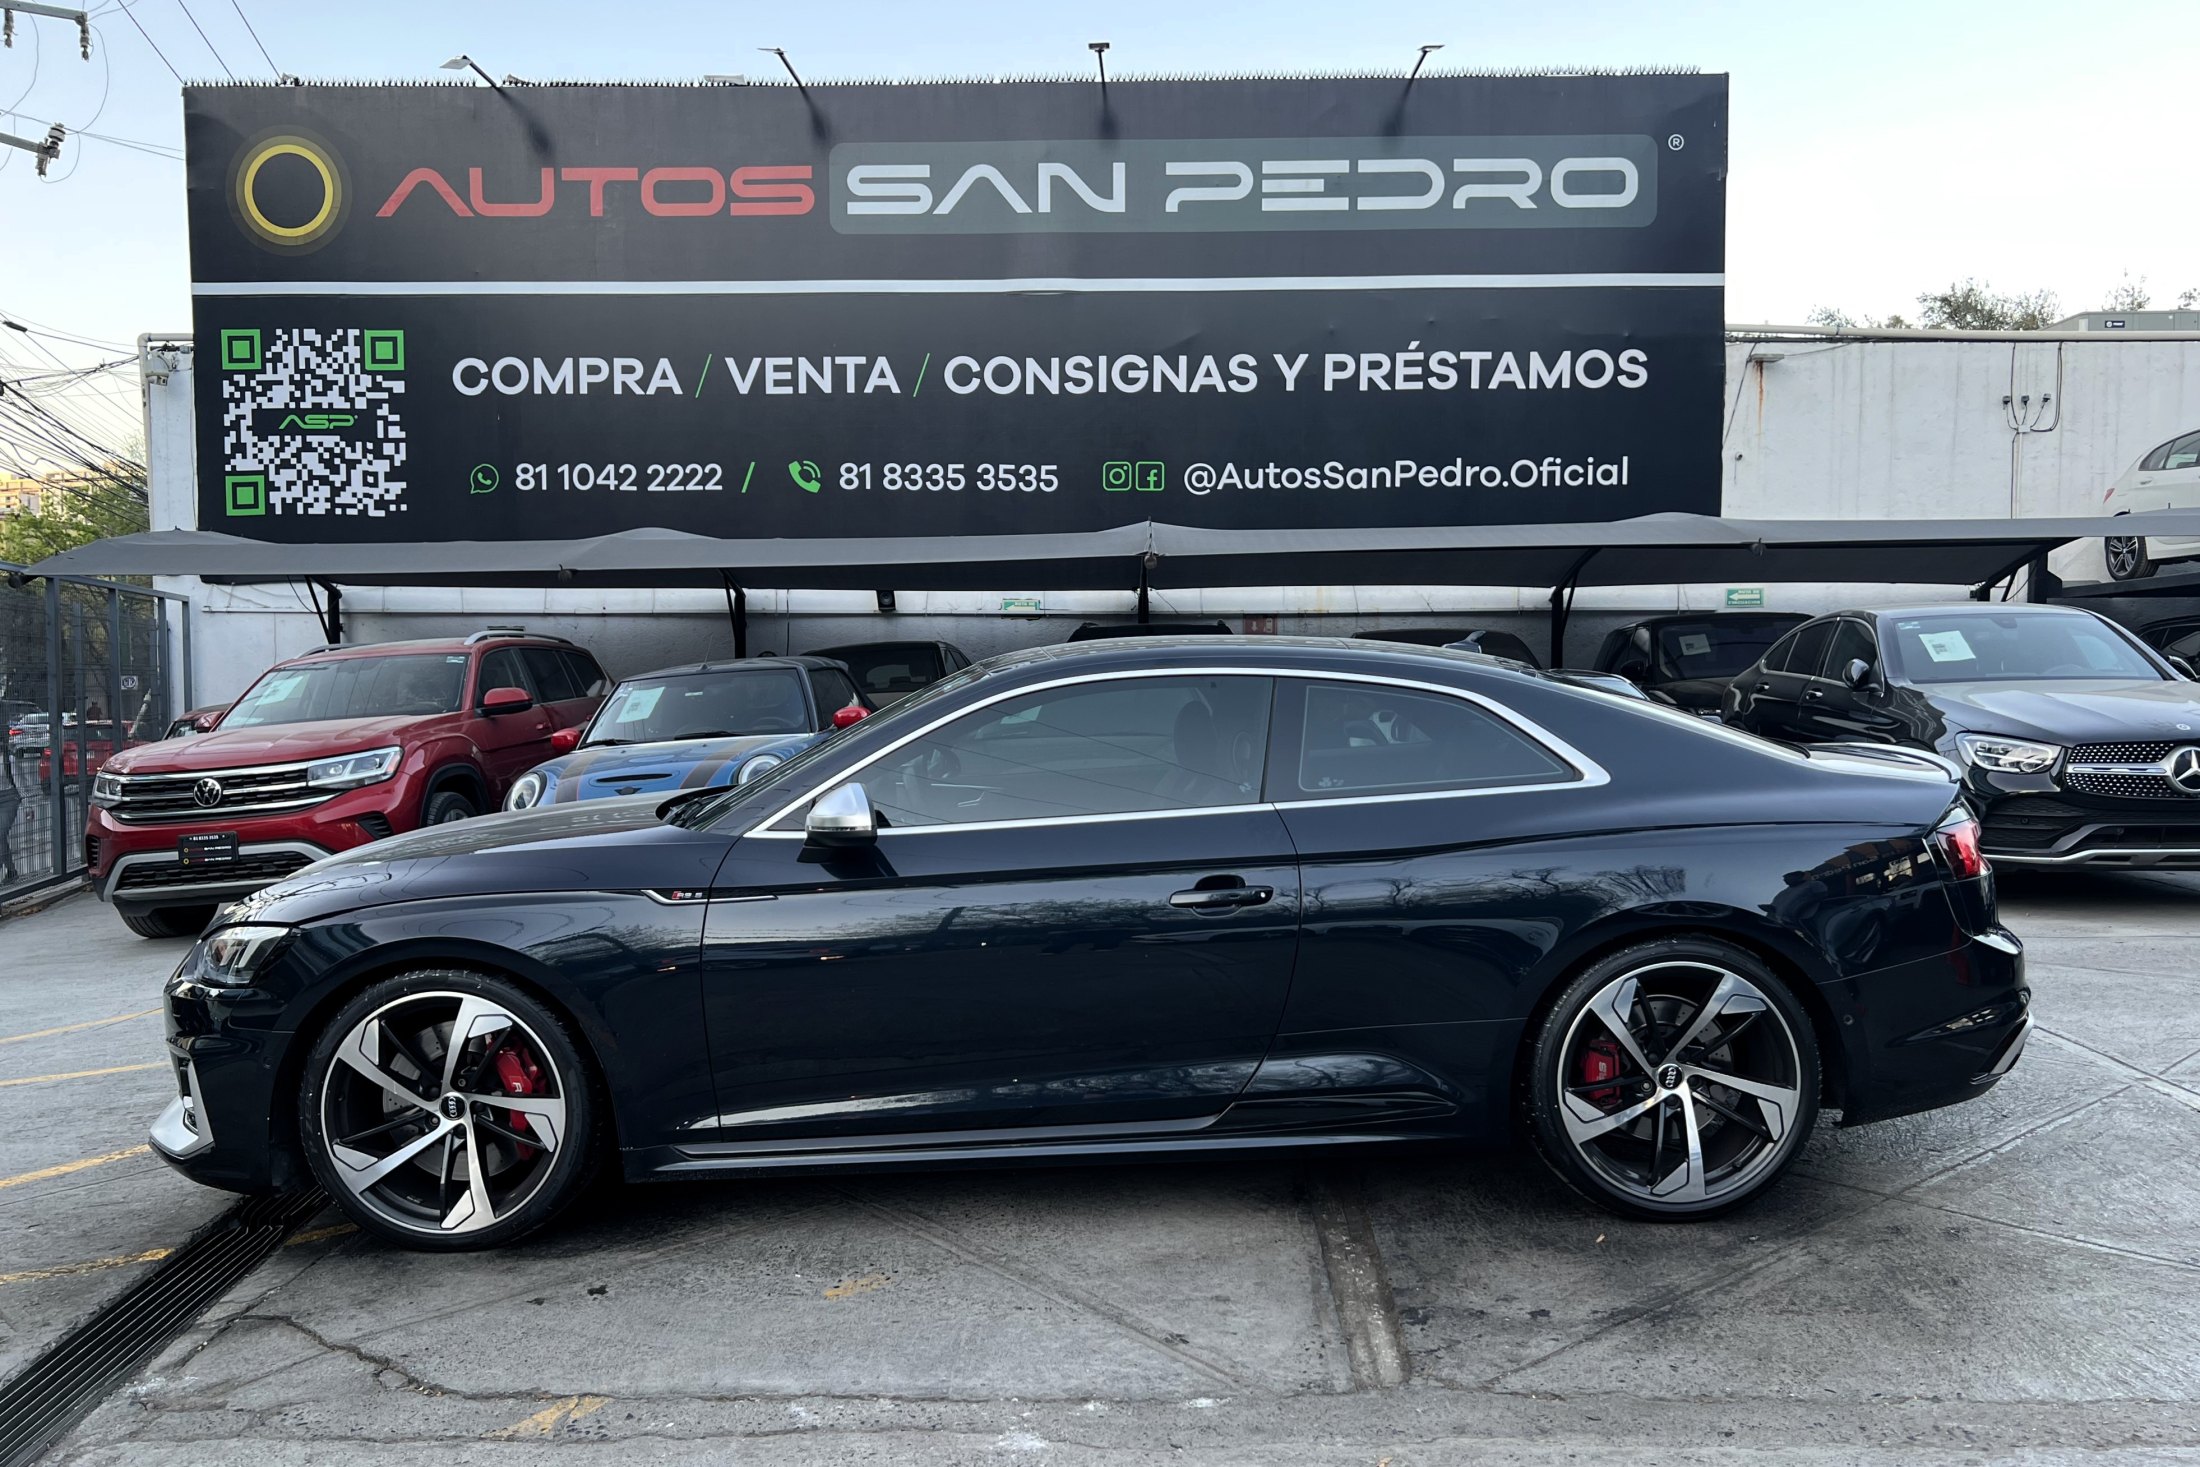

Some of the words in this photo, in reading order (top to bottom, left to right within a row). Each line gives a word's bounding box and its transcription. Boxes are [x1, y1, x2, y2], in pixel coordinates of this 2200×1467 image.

[376, 165, 815, 217] AUTOS
[845, 162, 1126, 216] SAN
[1165, 157, 1639, 214] PEDRO
[452, 356, 683, 397] COMPRA
[724, 355, 902, 395] VENTA
[943, 354, 1258, 395] CONSIGNAS
[1272, 353, 1309, 392] Y
[1324, 341, 1648, 393] PRÉSTAMOS
[278, 414, 355, 430] ASP
[515, 462, 547, 491] 81
[557, 462, 638, 492] 1042
[646, 462, 723, 492] 2222
[839, 462, 871, 490] 81
[882, 462, 966, 491] 8335
[976, 463, 1059, 492] 3535
[1183, 455, 1630, 497] @AutosSanPedro.Oficial
